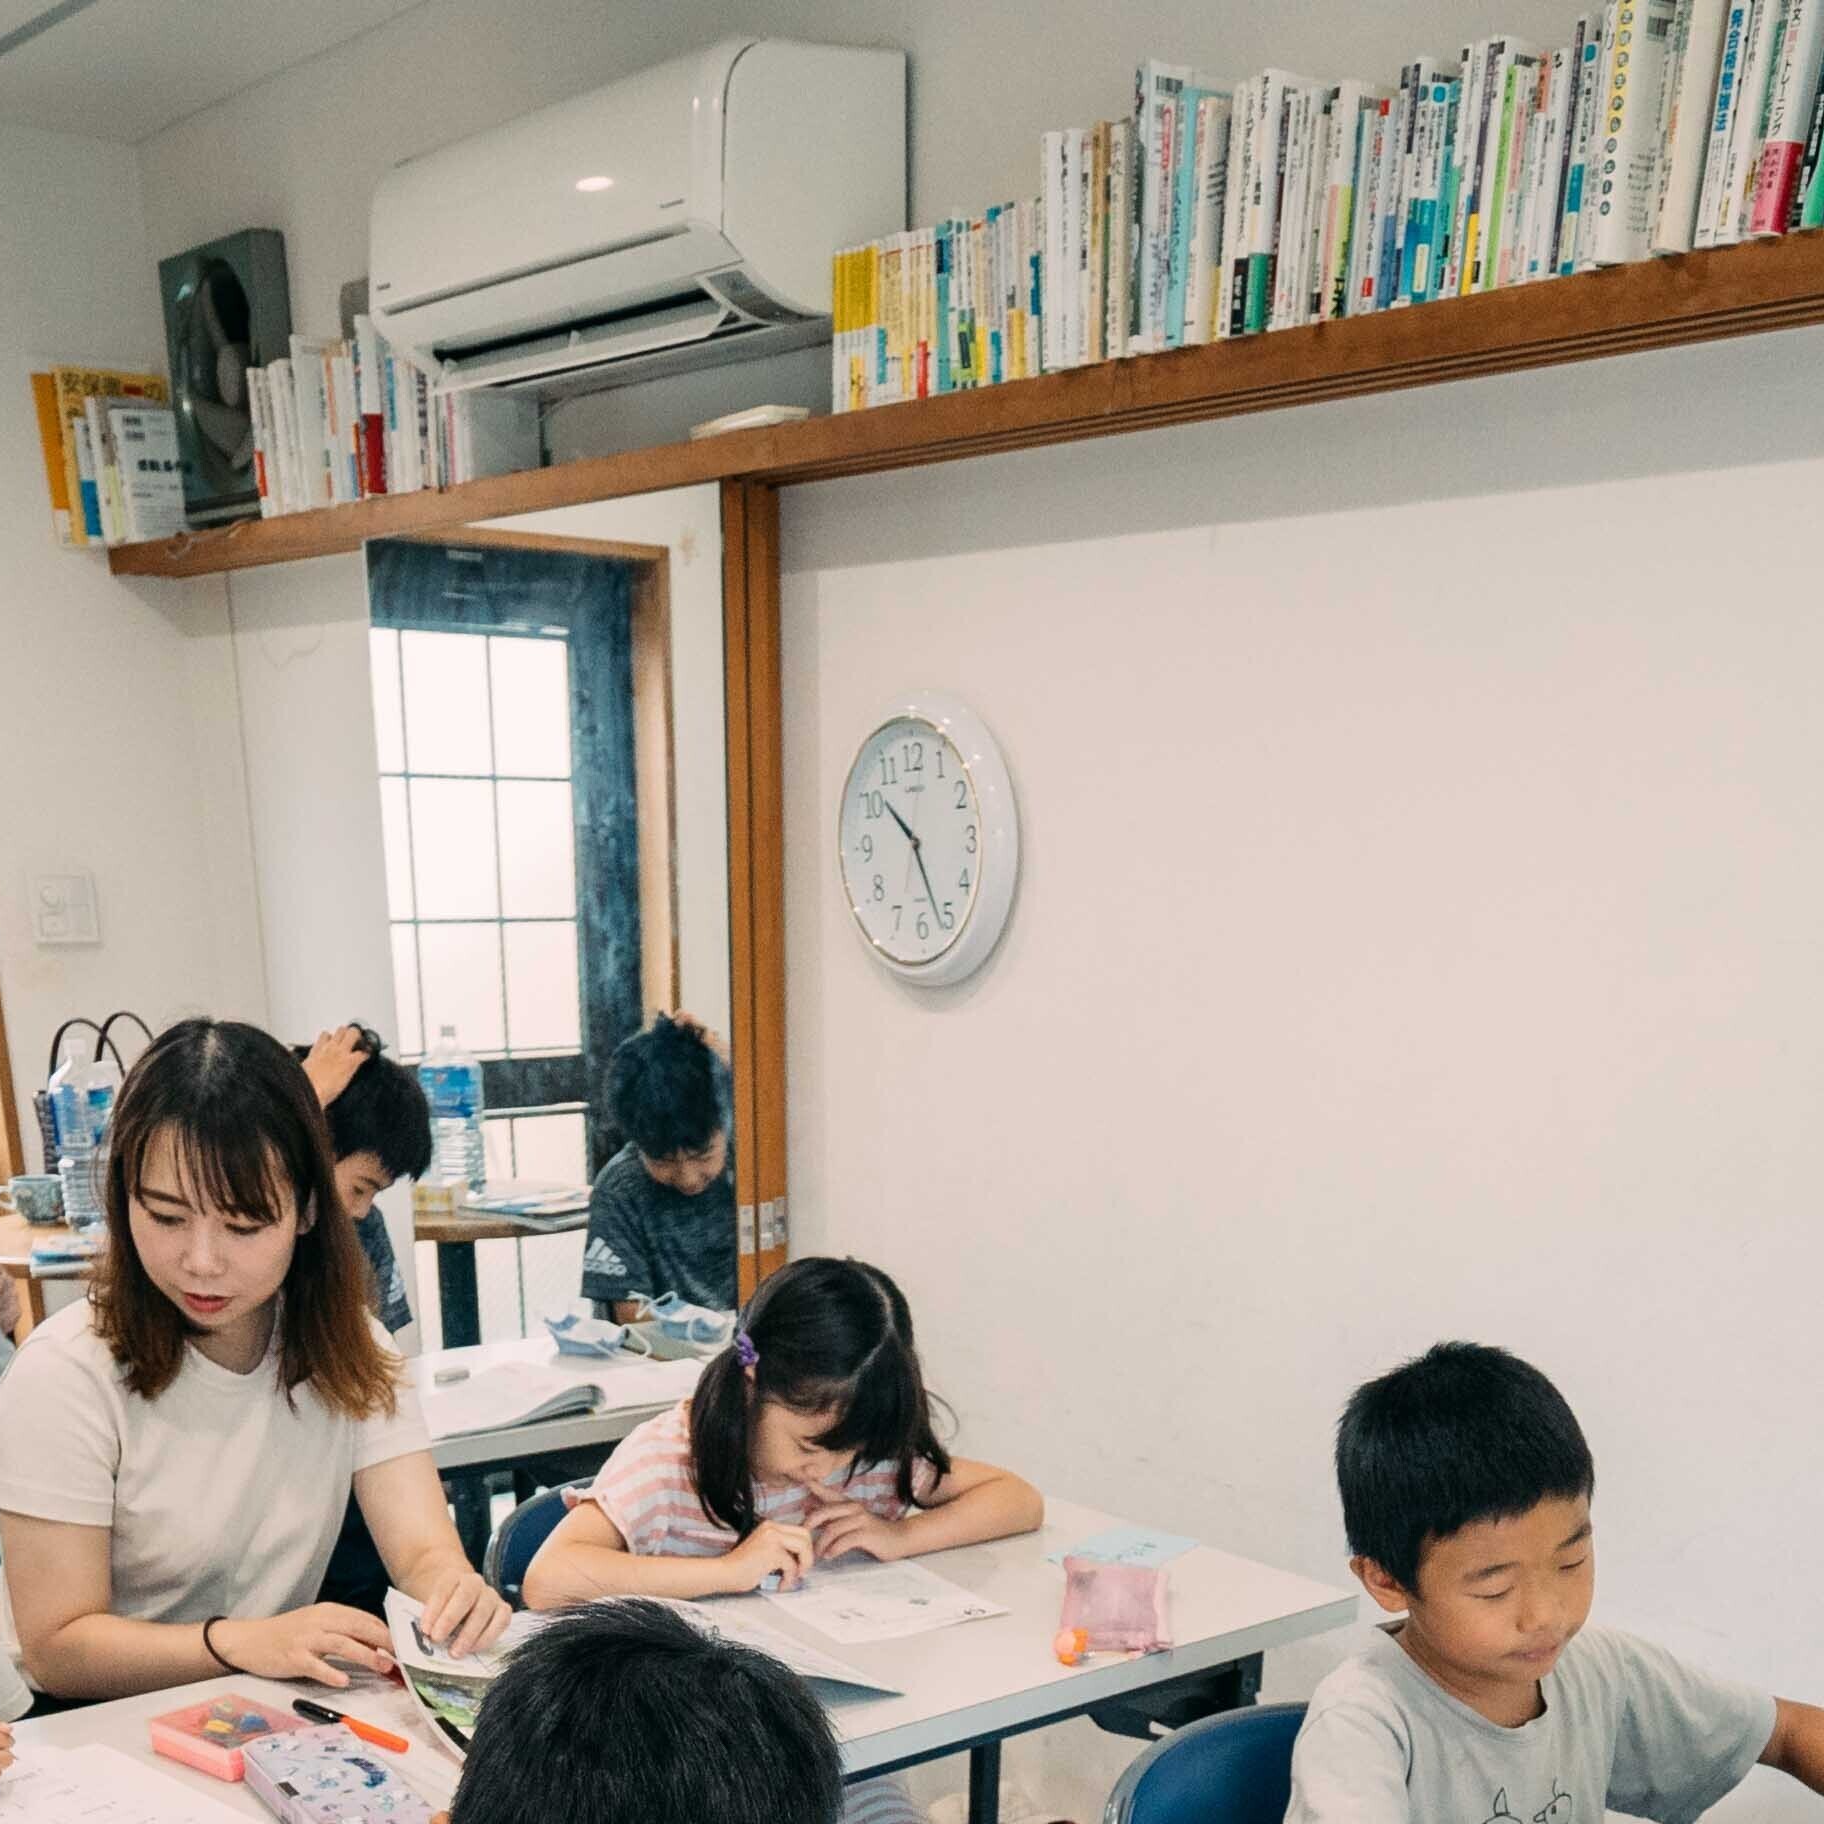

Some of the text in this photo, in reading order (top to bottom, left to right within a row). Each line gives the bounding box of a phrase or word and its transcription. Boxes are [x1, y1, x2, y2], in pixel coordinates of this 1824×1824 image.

[903, 742, 923, 772] 12
[936, 751, 944, 778] 1
[881, 757, 897, 786] 11
[859, 790, 884, 819] 10
[954, 780, 967, 809] 2
[861, 834, 873, 863] 9
[965, 825, 977, 854] 3
[873, 874, 885, 902] 8
[959, 868, 970, 895] 4
[891, 905, 902, 931] 7
[917, 912, 929, 940] 6
[943, 902, 955, 930] 5
